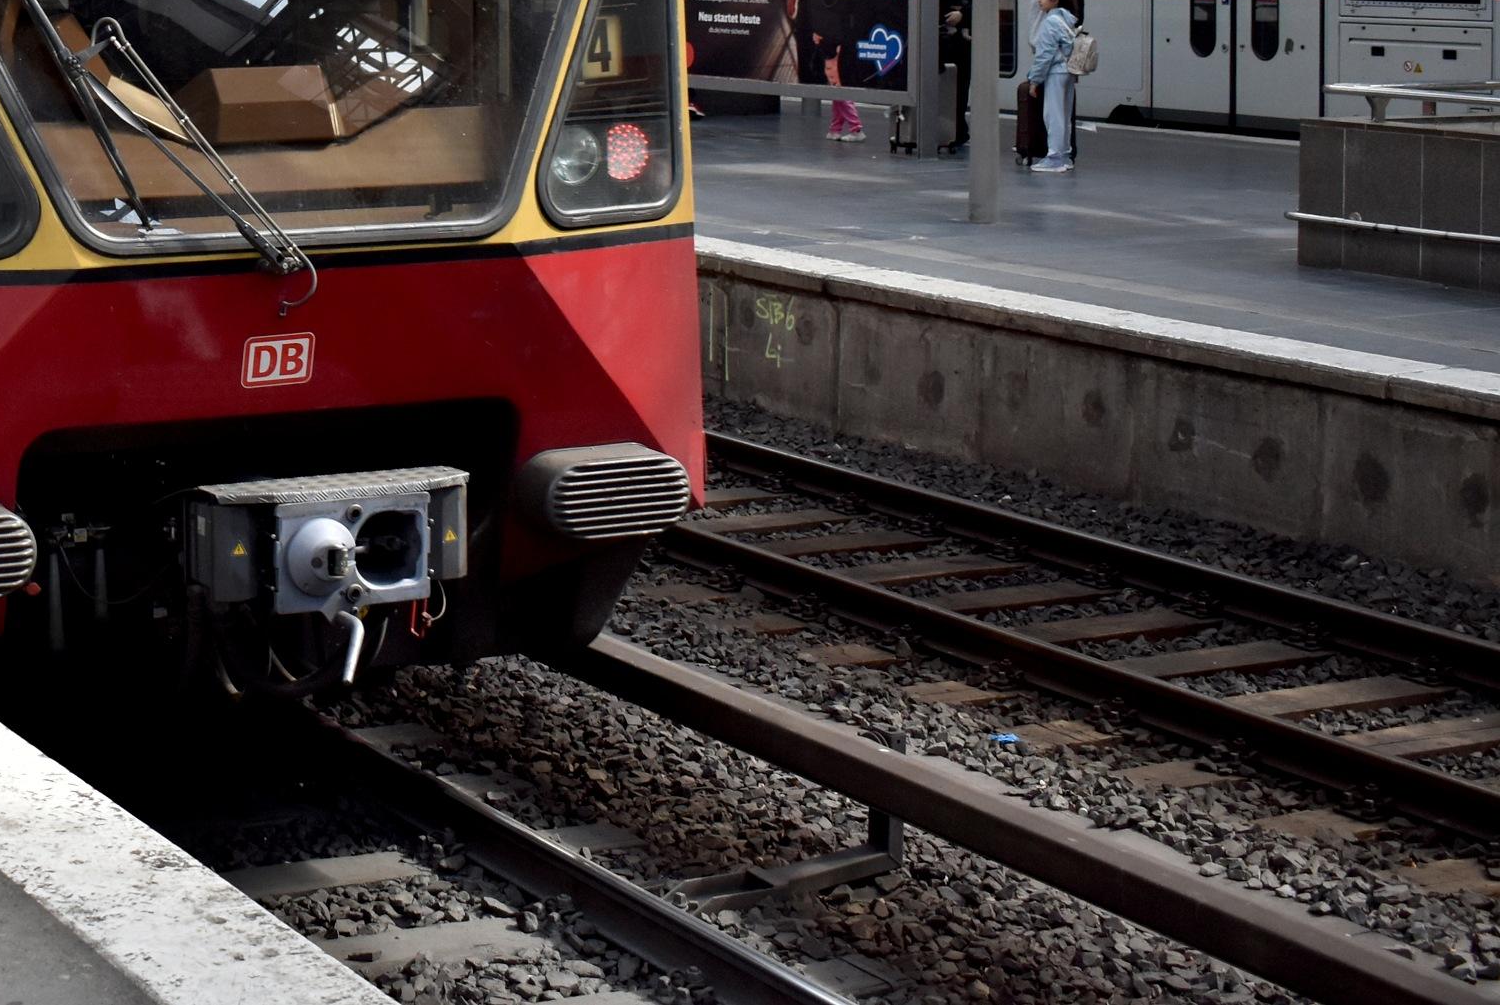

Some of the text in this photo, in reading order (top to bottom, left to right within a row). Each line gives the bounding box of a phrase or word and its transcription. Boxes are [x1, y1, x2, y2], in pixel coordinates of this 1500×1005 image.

[698, 11, 761, 25] Neu startet heute
[587, 19, 612, 72] 4
[250, 341, 306, 380] DB
